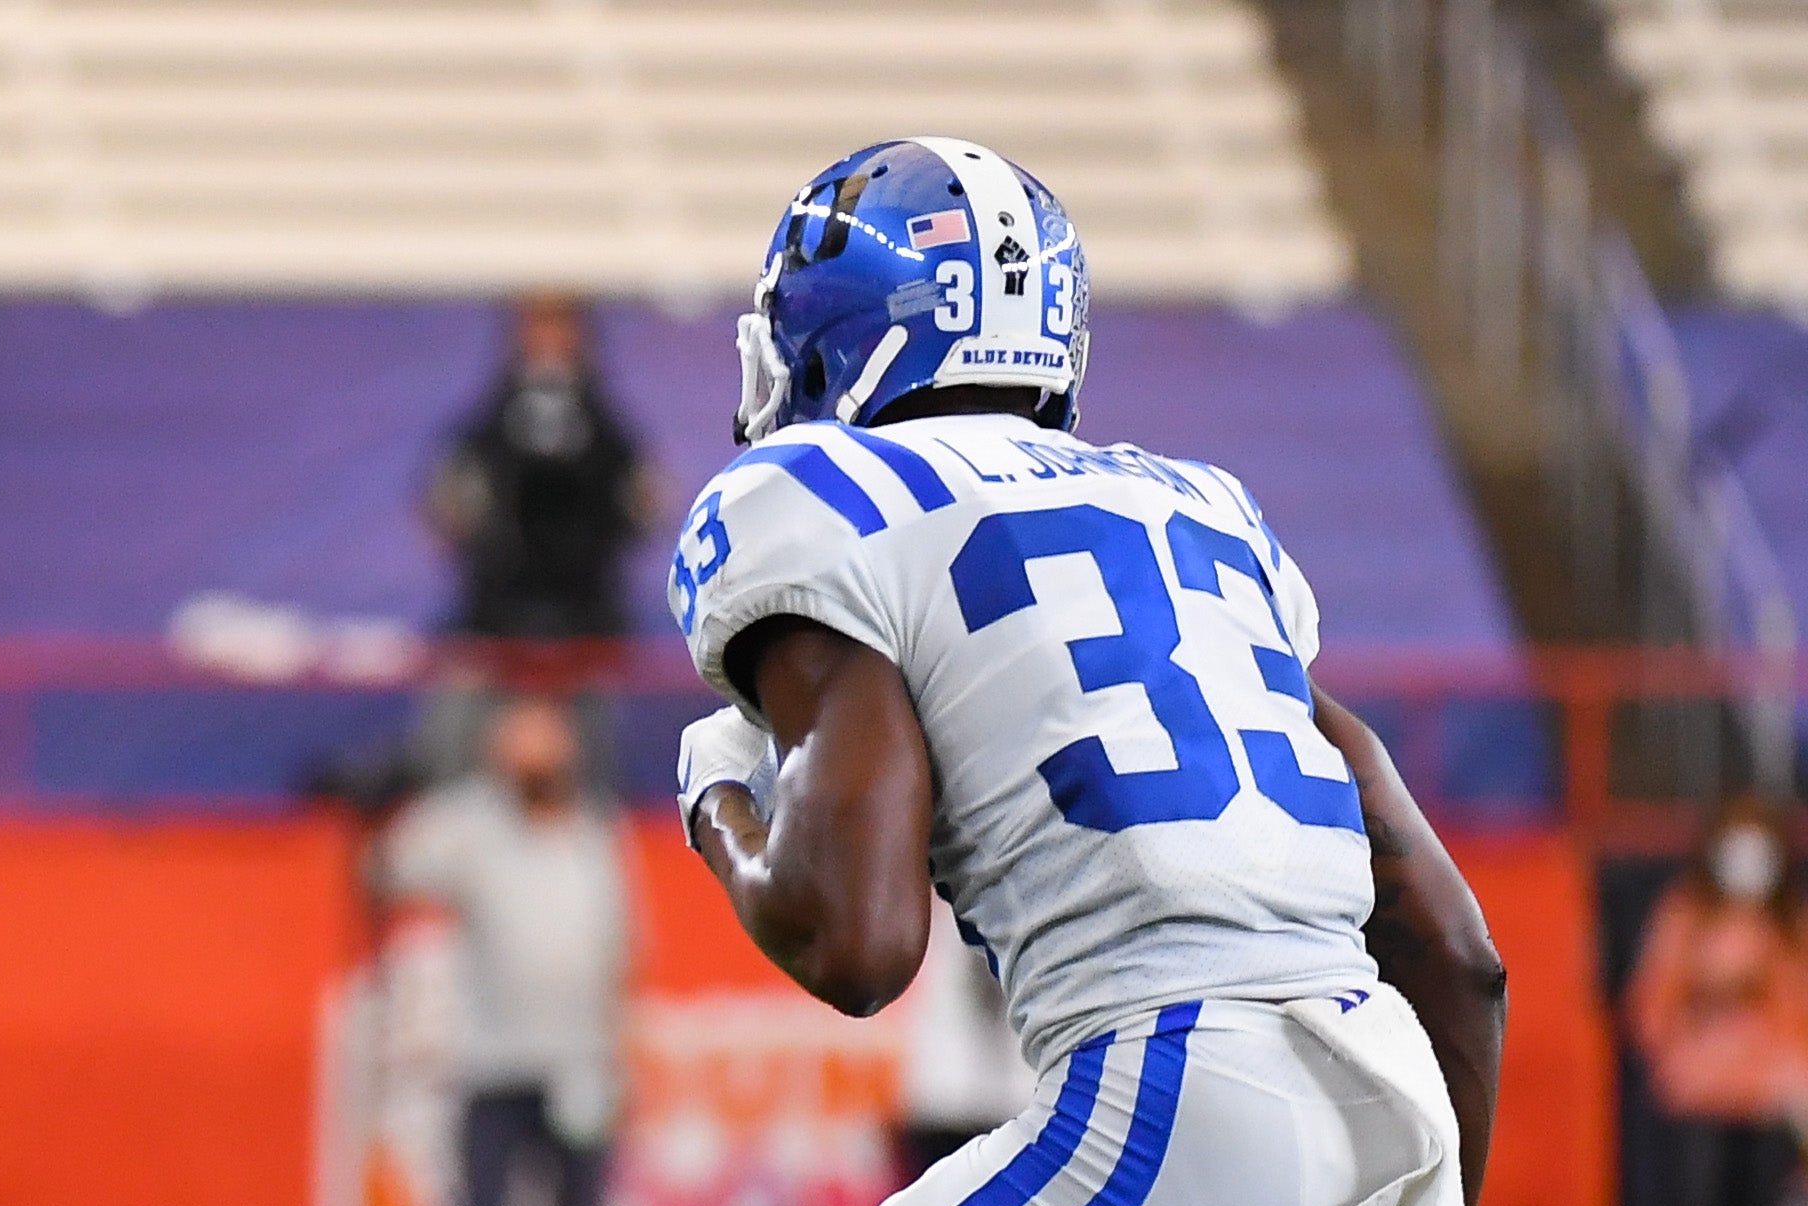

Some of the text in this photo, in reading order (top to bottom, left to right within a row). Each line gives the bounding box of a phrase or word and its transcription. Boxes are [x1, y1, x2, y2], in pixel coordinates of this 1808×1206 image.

[934, 260, 1073, 335] 3 3
[961, 350, 1064, 369] BLUE DEVILS
[949, 503, 1366, 833] 33
